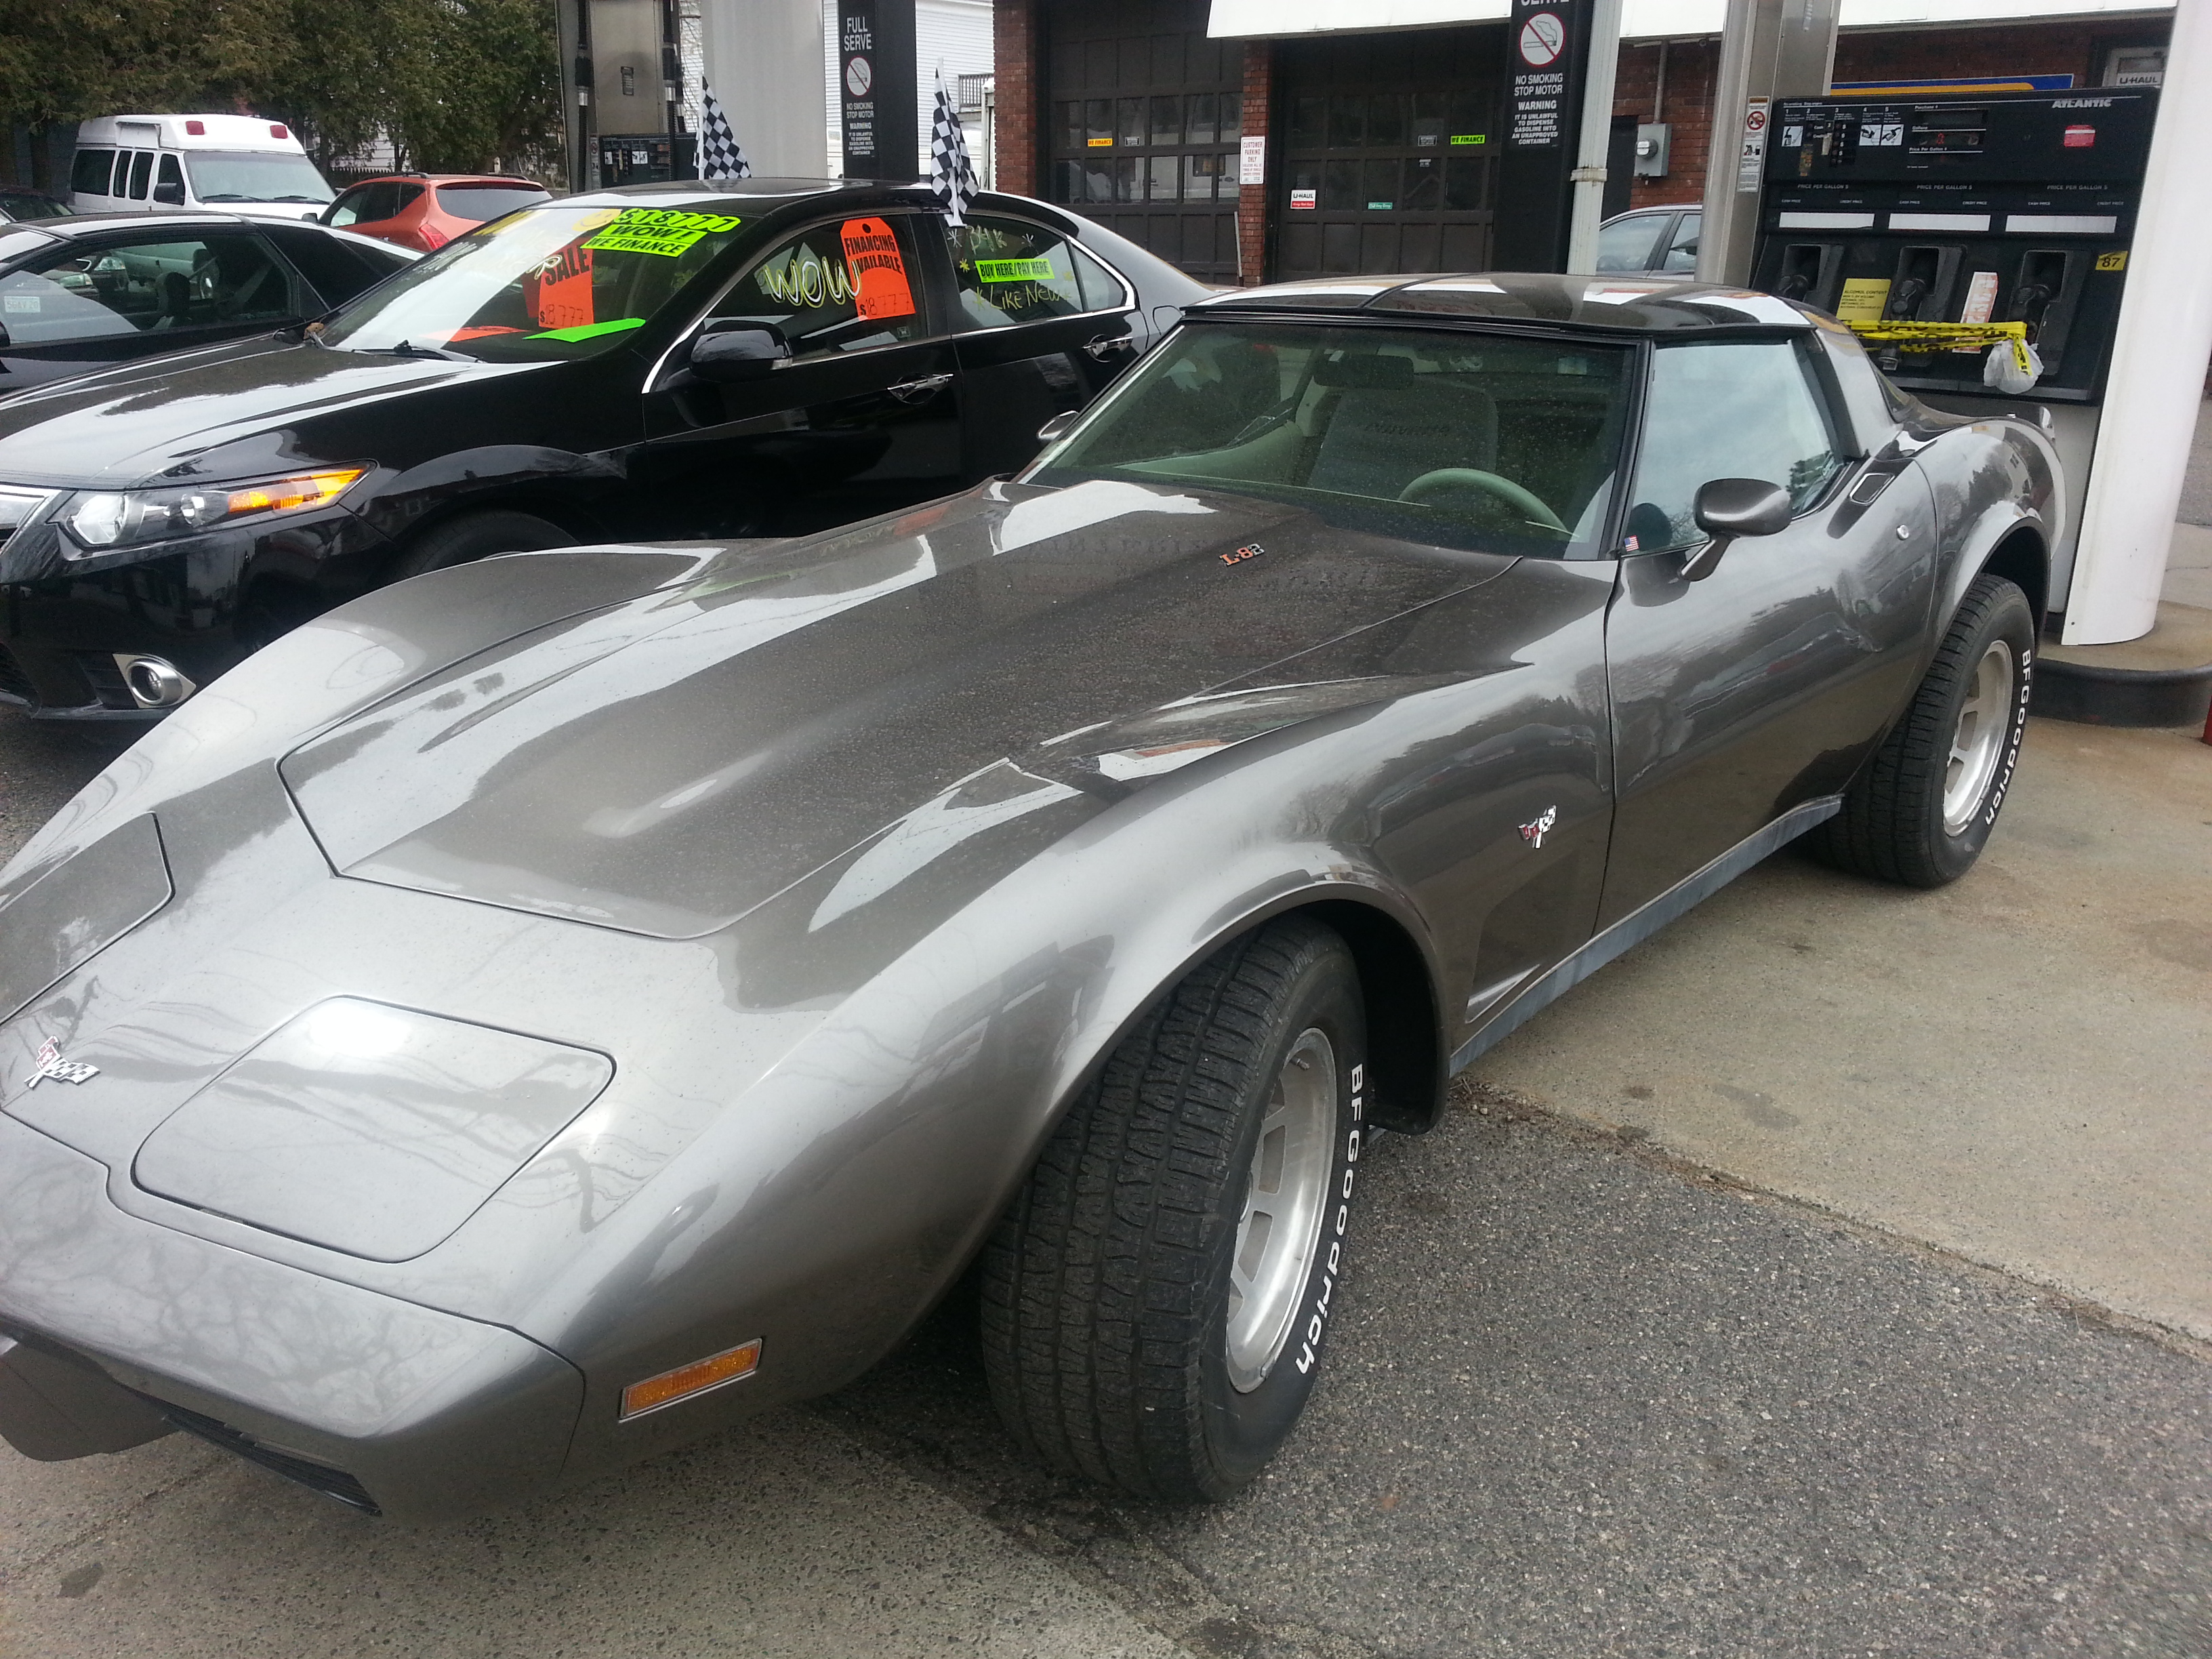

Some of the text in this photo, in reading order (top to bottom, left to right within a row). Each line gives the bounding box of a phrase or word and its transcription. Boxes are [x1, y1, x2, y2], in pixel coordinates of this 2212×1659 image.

[846, 16, 868, 33] FULL
[844, 33, 872, 52] SERVE
[1515, 73, 1563, 85] NO SMOKING
[2119, 76, 2157, 85] U-HAUL
[1514, 84, 1563, 96] STOP MOTOR
[853, 102, 874, 110] SMOKING
[1518, 100, 1557, 110] WARNING
[2051, 98, 2113, 108] ATLANTIC
[859, 110, 874, 119] MOTOR
[585, 237, 686, 254] WE FINANCE
[844, 234, 897, 256] FINANCING
[545, 245, 590, 286] SALE
[979, 261, 1050, 279] BUY HERE/PAY HERE
[2102, 258, 2121, 268] 87
[764, 256, 863, 308] WOW
[990, 285, 1023, 310] LIKE
[1219, 543, 1265, 567] L-82
[1985, 649, 2032, 825] BFGoodrich
[1295, 1063, 1364, 1374] BFGoodrich
